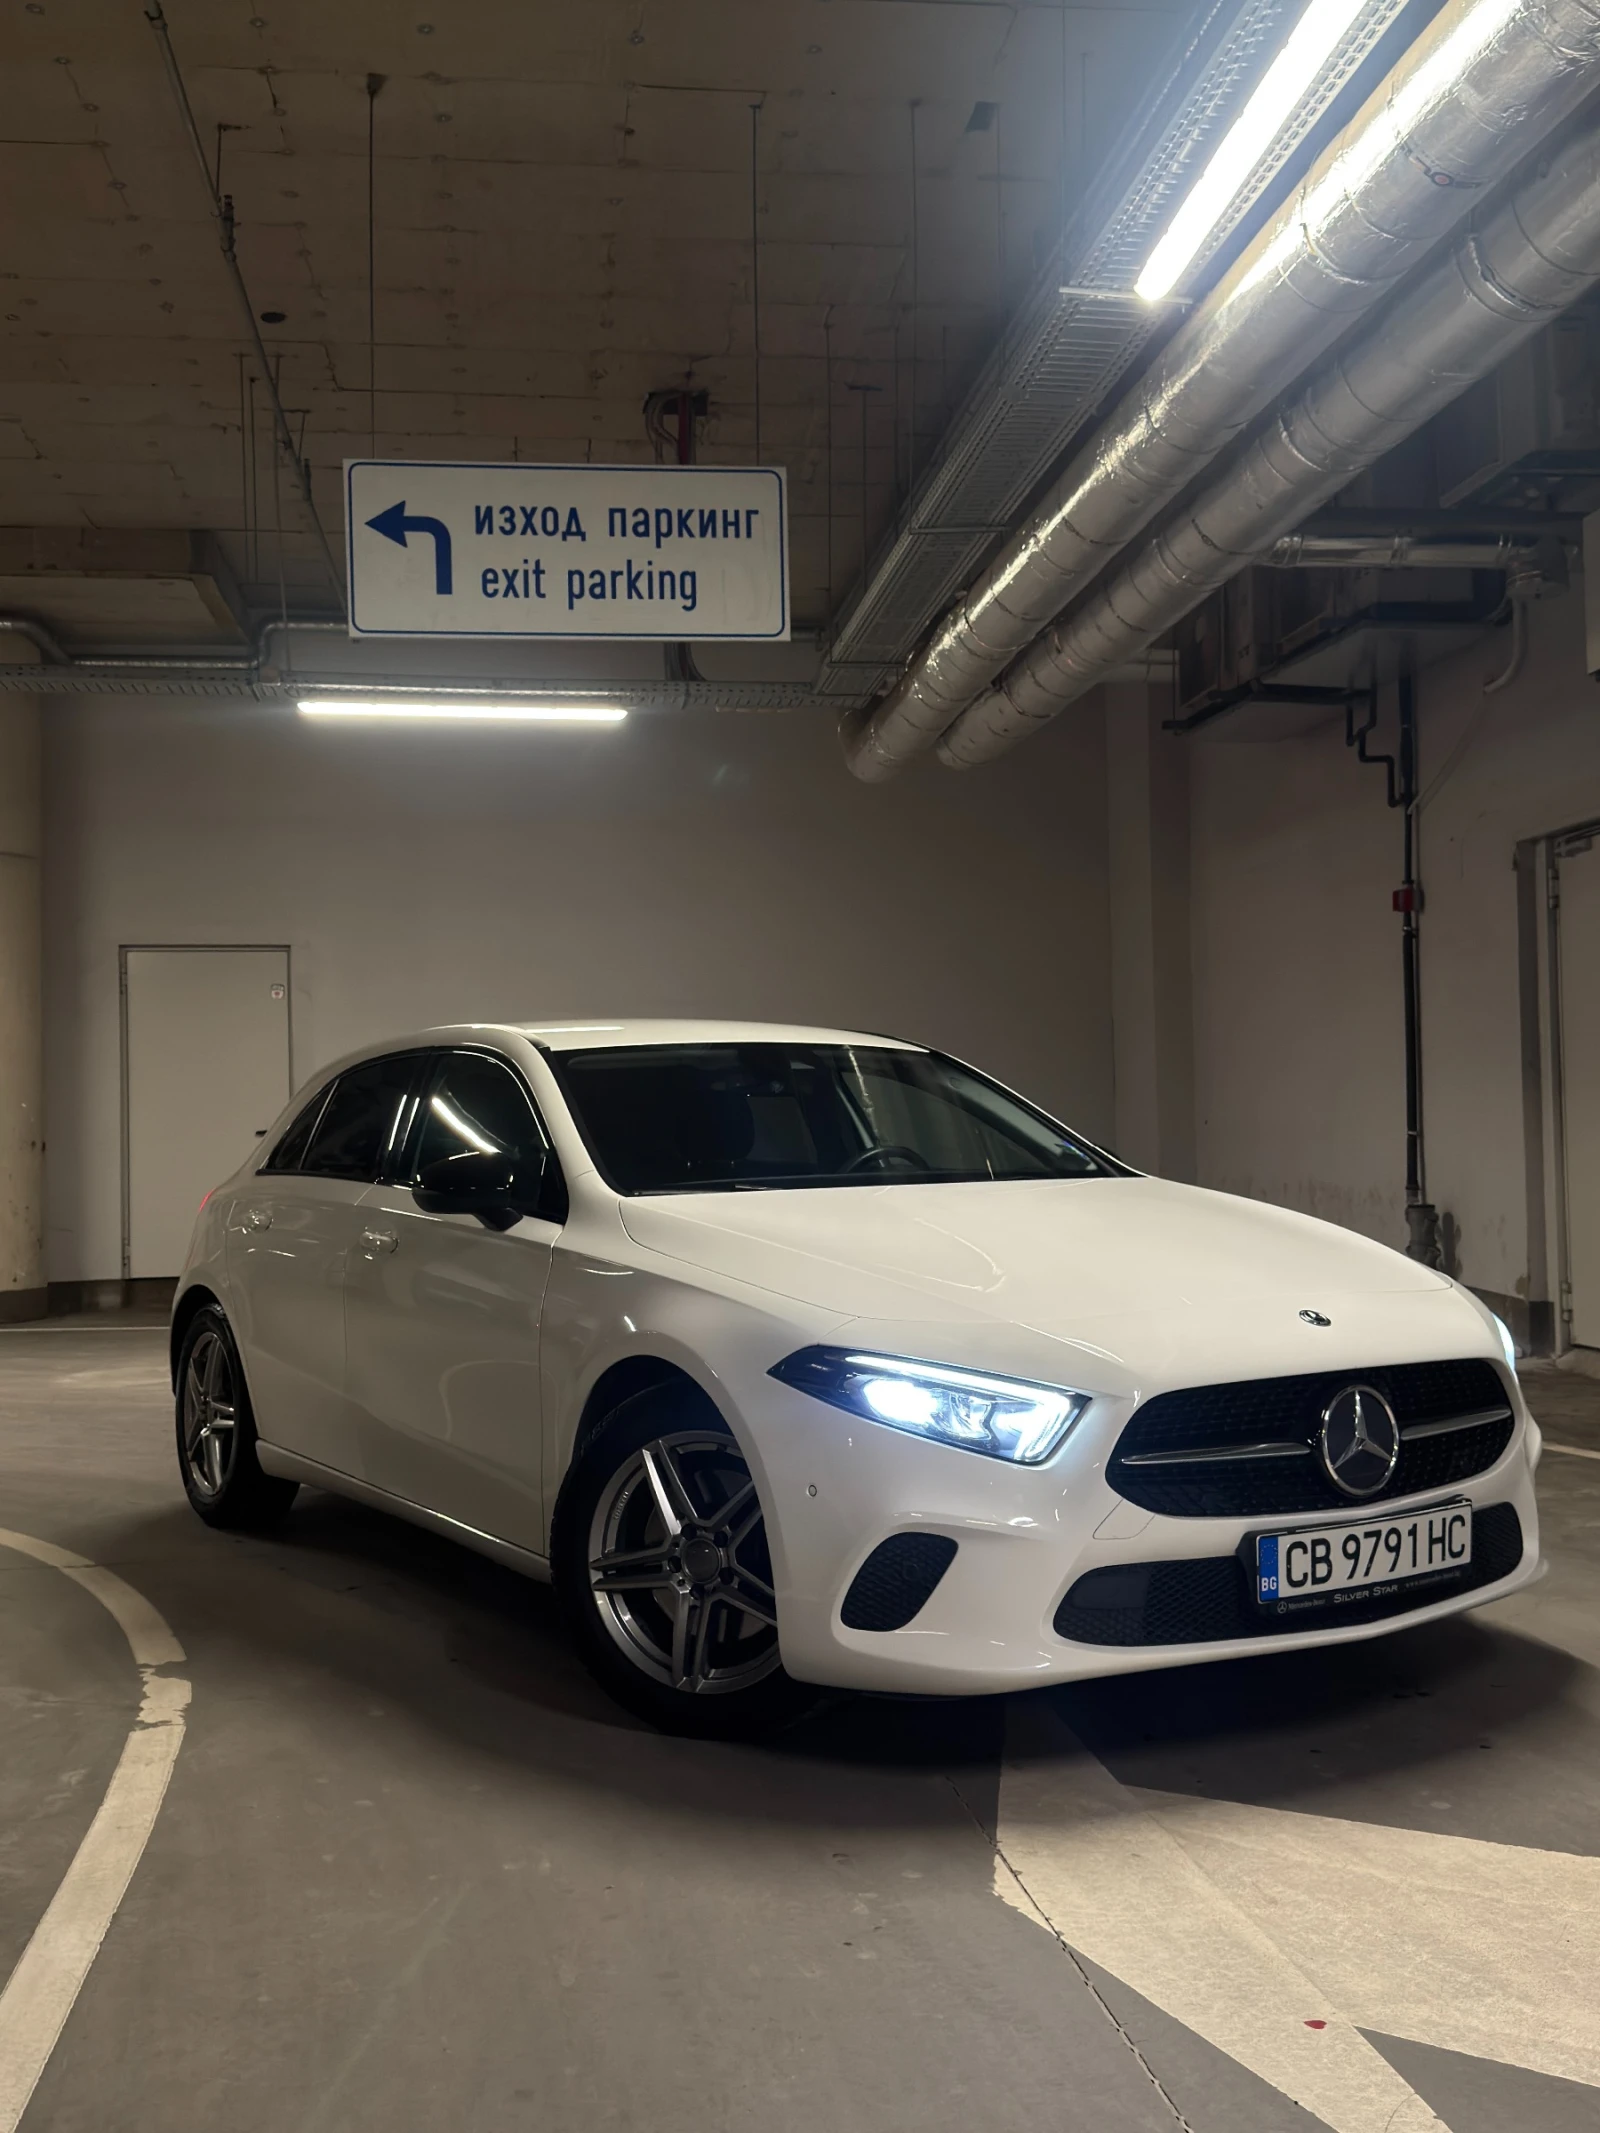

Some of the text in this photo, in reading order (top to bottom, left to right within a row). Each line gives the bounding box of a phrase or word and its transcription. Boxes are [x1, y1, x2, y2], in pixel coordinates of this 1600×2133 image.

[475, 505, 759, 549] изход паркинг
[481, 559, 697, 612] exit parking
[1286, 1514, 1466, 1588] CB 9791 HC
[1261, 1576, 1277, 1591] BG
[1333, 1584, 1398, 1604] SILVER STAR
